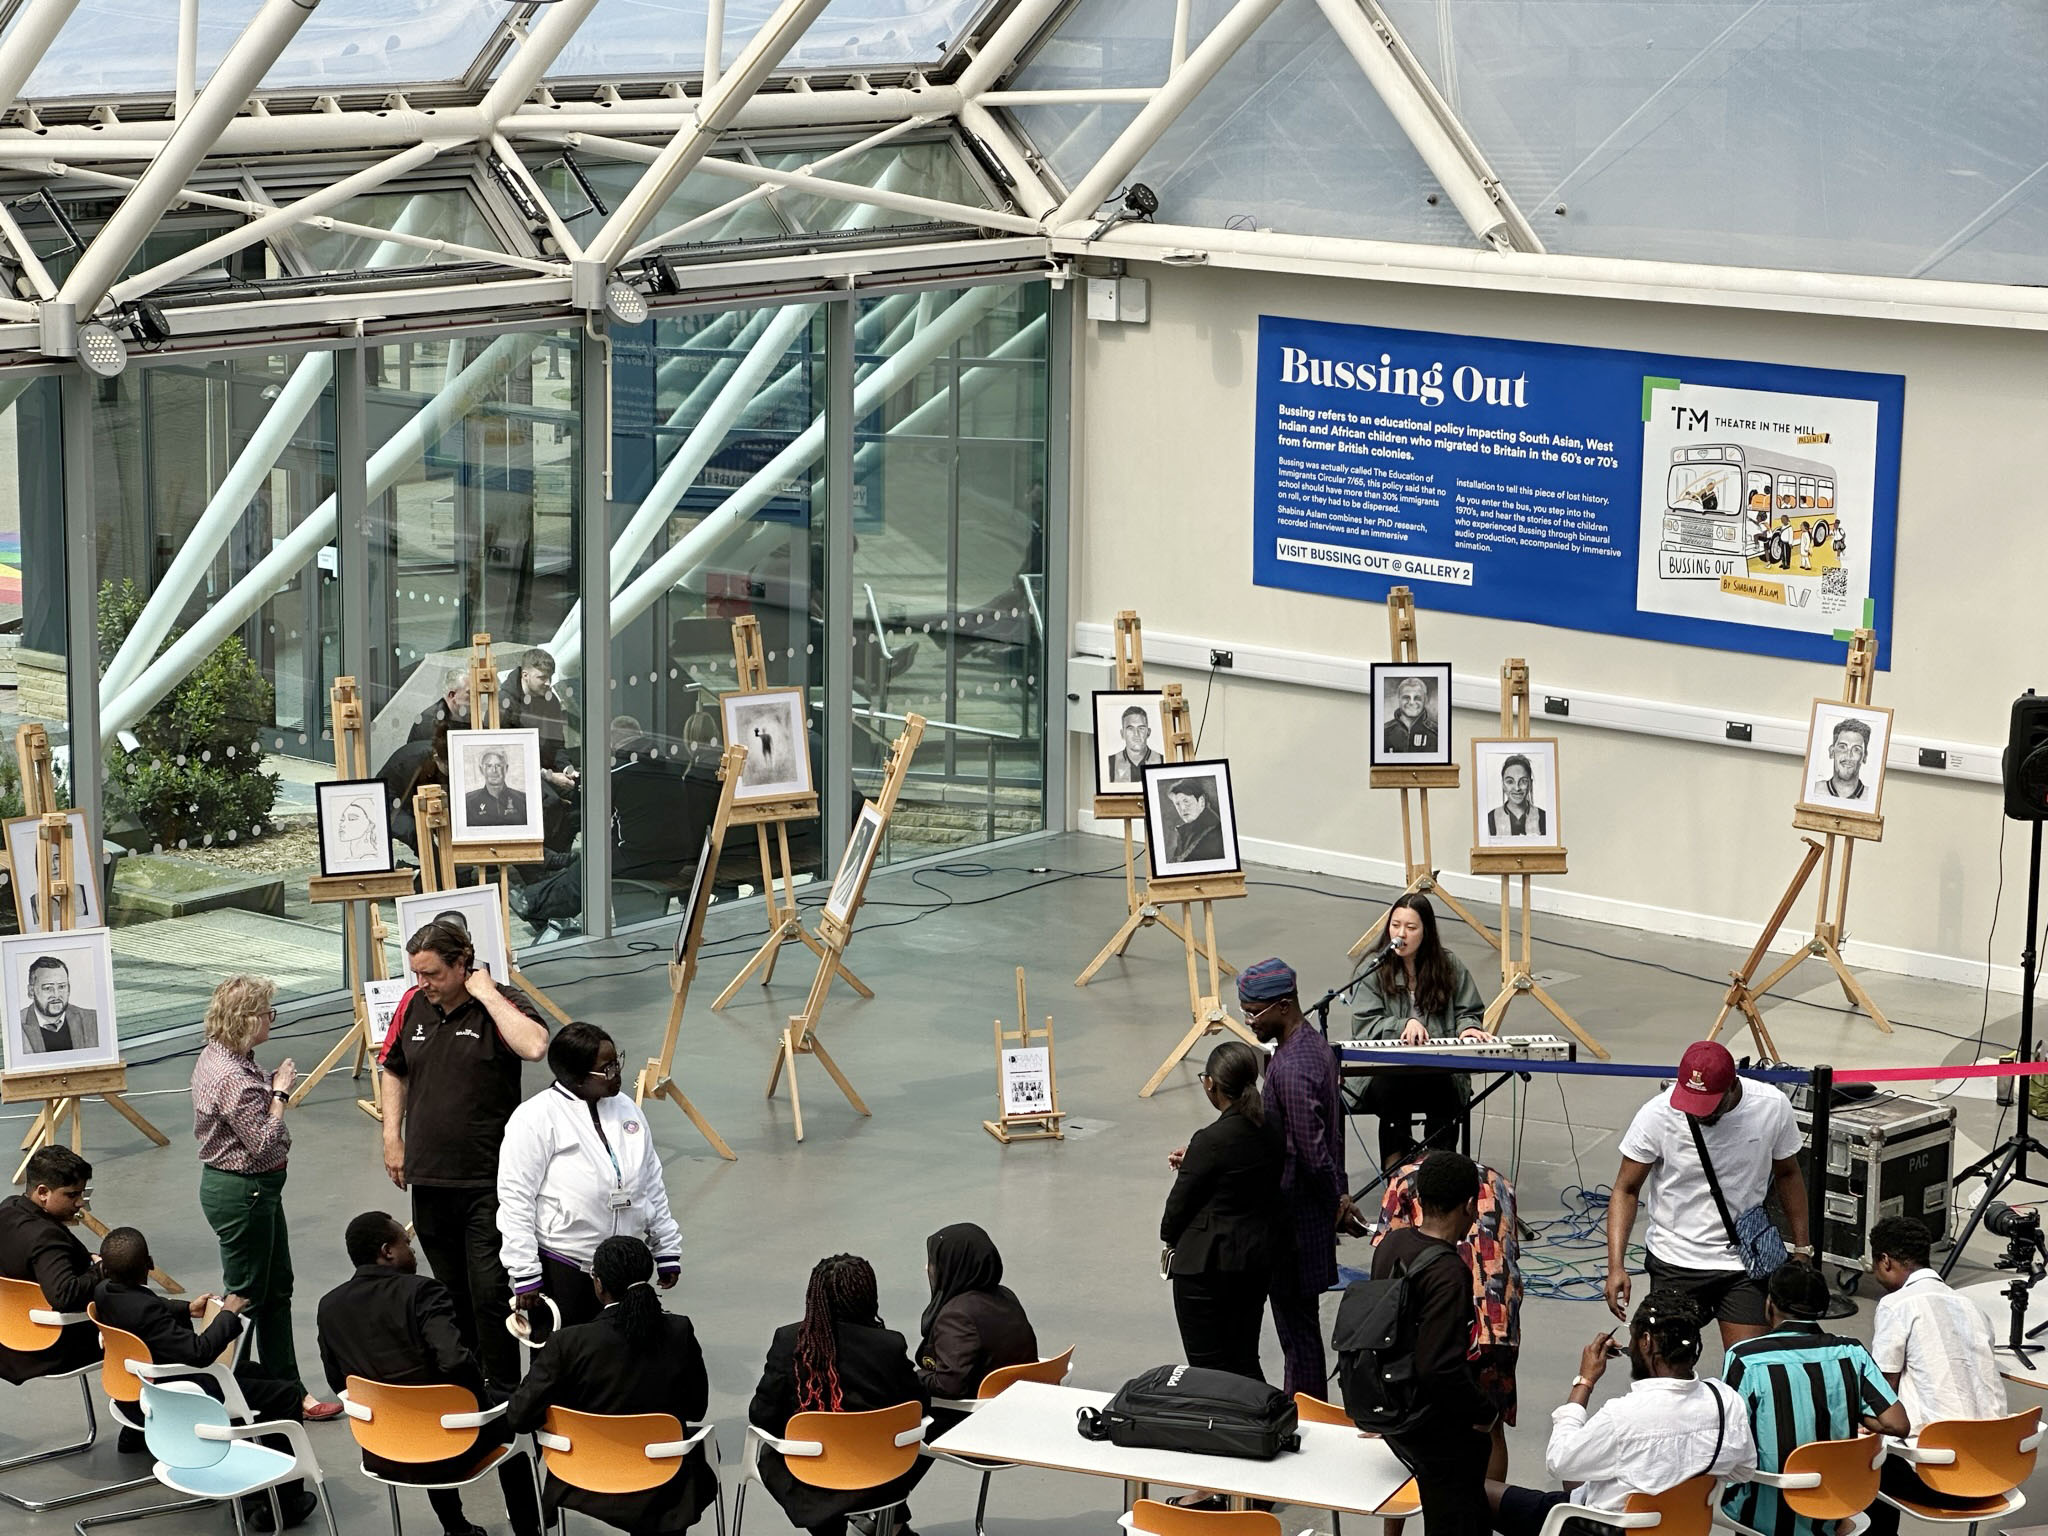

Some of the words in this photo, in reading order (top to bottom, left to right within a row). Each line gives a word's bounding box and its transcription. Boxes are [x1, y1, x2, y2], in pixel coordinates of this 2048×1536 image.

[1280, 347, 1444, 407] Bussing
[1452, 365, 1529, 408] Out
[1278, 405, 1315, 420] Bussing
[1317, 410, 1346, 421] refers
[1347, 413, 1358, 423] to
[1359, 416, 1371, 424] an
[1373, 416, 1431, 431] educational
[1434, 423, 1464, 437] policy
[1466, 426, 1516, 443] impacting
[1518, 432, 1549, 444] South
[1551, 436, 1583, 449] Asian,
[1586, 440, 1613, 452] West
[1715, 417, 1756, 430] THEATRE
[1759, 421, 1770, 431] IN
[1773, 423, 1790, 433] THE
[1794, 426, 1817, 436] MILL
[1278, 420, 1307, 432] Indian
[1309, 425, 1328, 435] and
[1330, 426, 1365, 439] African
[1367, 431, 1407, 444] children
[1409, 436, 1432, 446] who
[1434, 438, 1478, 452] migrated
[1480, 444, 1491, 453] to
[1493, 445, 1526, 457] Britain
[1528, 449, 1538, 459] in
[1540, 451, 1558, 461] the
[1583, 457, 1595, 465] or
[1278, 435, 1300, 446] from
[1301, 438, 1336, 451] former
[1337, 442, 1369, 454] British
[1370, 447, 1414, 460] colonies.
[1278, 457, 1304, 469] Bussing
[1320, 464, 1349, 474] actually
[1349, 467, 1372, 475] called
[1373, 469, 1387, 477] The
[1388, 471, 1424, 481] Education
[1425, 475, 1433, 483] of
[1278, 468, 1316, 480] Immigrants
[1317, 473, 1346, 483] Circular
[1367, 479, 1380, 488] this
[1381, 482, 1403, 492] policy
[1404, 484, 1419, 492] said
[1420, 486, 1435, 494] that
[1278, 480, 1300, 489] school
[1301, 483, 1324, 492] should
[1325, 485, 1342, 494] have
[1343, 489, 1363, 497] more
[1363, 490, 1381, 499] than
[1382, 492, 1398, 501] 30%
[1399, 495, 1439, 506] immigrants
[1287, 492, 1301, 501] roll,
[1311, 495, 1327, 505] they
[1328, 497, 1341, 505] had
[1342, 499, 1350, 507] to
[1351, 500, 1361, 508] be
[1362, 502, 1400, 513] dispersed.
[1456, 479, 1495, 490] installation
[1496, 484, 1504, 492] to
[1505, 485, 1518, 493] tell
[1519, 487, 1533, 495] this
[1534, 489, 1555, 498] piece
[1556, 491, 1565, 499] of
[1566, 492, 1580, 501] lost
[1581, 494, 1609, 505] history.
[1277, 506, 1305, 516] Shabina
[1305, 509, 1327, 519] Aslam
[1328, 514, 1362, 523] combines
[1363, 517, 1376, 525] her
[1377, 519, 1393, 527] PhD
[1394, 522, 1427, 532] research,
[1455, 495, 1465, 503] As
[1481, 499, 1501, 507] enter
[1501, 501, 1514, 509] the
[1515, 502, 1531, 512] bus,
[1548, 507, 1565, 517] step
[1566, 508, 1581, 517] into
[1582, 511, 1595, 519] the
[1277, 519, 1308, 527] recorded
[1309, 521, 1345, 532] interviews
[1370, 529, 1408, 540] immersive
[1454, 518, 1470, 526] who
[1471, 521, 1516, 532] experienced
[1518, 525, 1546, 537] Bussing
[1547, 530, 1577, 541] through
[1579, 533, 1610, 544] binaural
[1480, 510, 1494, 518] and
[1495, 511, 1512, 520] hear
[1513, 514, 1525, 522] the
[1526, 516, 1552, 525] stories
[1562, 520, 1575, 528] the
[1576, 521, 1608, 532] children
[1454, 530, 1475, 538] audio
[1476, 533, 1518, 544] production,
[1519, 539, 1569, 550] accompanied
[1571, 544, 1581, 553] by
[1582, 545, 1621, 557] immersive
[1454, 541, 1492, 551] animation.
[1278, 543, 1308, 558] VISIT
[1310, 548, 1361, 566] BUSSING
[1364, 556, 1390, 570] OUT
[1392, 559, 1402, 572] @
[1404, 562, 1460, 579] GALLERY
[1462, 569, 1470, 580] 2
[1715, 560, 1735, 576] OUT
[1909, 1153, 1929, 1173] PAC
